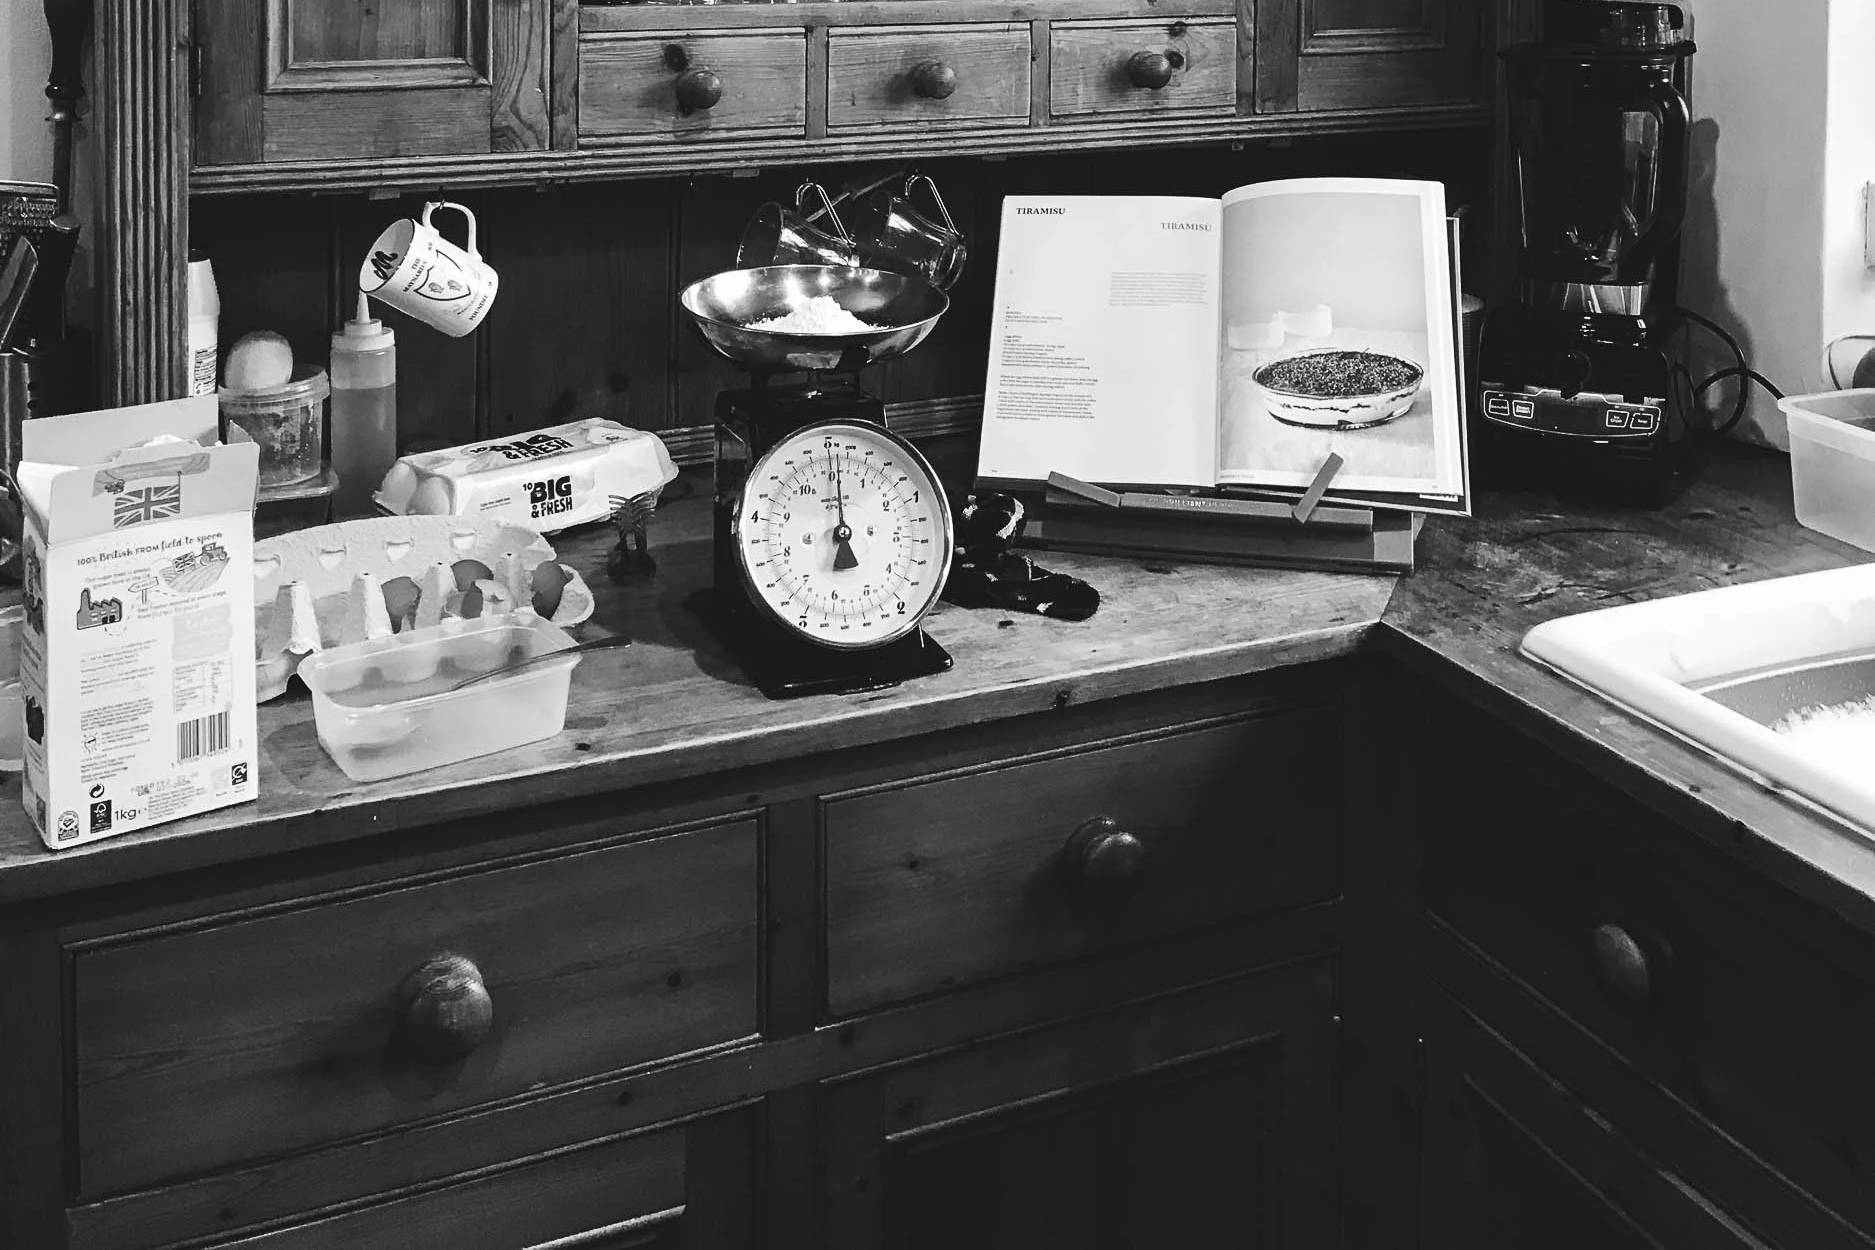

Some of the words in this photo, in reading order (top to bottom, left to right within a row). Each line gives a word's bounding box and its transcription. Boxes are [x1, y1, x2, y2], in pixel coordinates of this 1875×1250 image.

[1016, 207, 1066, 215] TIRAMISU
[519, 439, 575, 458] FRESH
[823, 436, 832, 449] 5
[829, 471, 836, 482] 0
[860, 478, 865, 489] 1
[522, 482, 534, 491] 10
[530, 476, 572, 504] BIG
[800, 484, 812, 496] 10
[913, 490, 919, 504] 1
[531, 504, 540, 518] &
[541, 497, 573, 517] FRESH
[883, 500, 890, 512] 2
[751, 510, 759, 524] 4
[783, 512, 791, 523] 9
[77, 556, 98, 567] 100%
[99, 546, 134, 563] British
[135, 544, 159, 556] FROM
[161, 538, 182, 552] field
[185, 535, 194, 545] to
[197, 531, 223, 545] spoon
[783, 545, 791, 557] 8
[886, 563, 892, 574] 4
[831, 590, 839, 601] 6
[897, 601, 905, 615] 2
